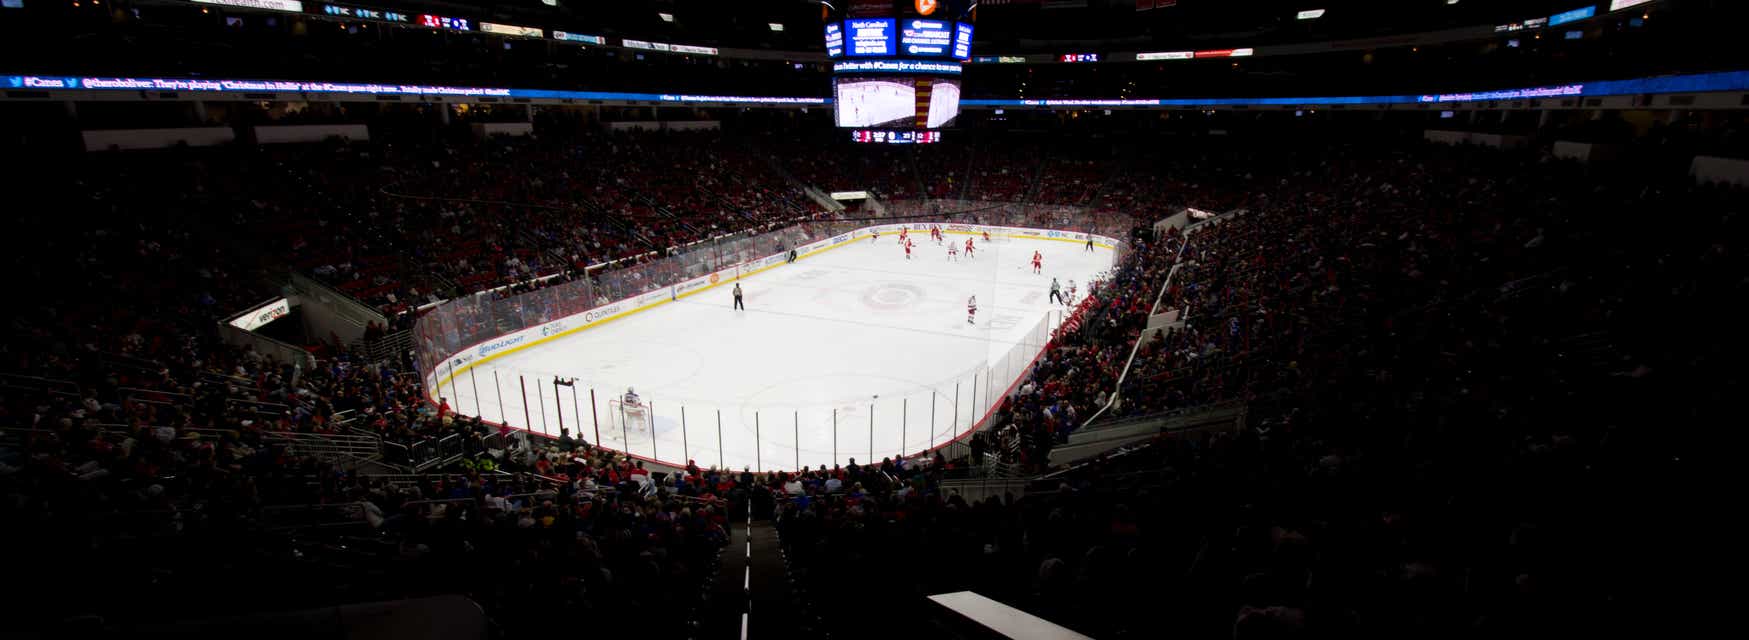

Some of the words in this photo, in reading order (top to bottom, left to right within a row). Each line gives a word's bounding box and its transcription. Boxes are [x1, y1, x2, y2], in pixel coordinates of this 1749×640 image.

[860, 62, 873, 70] with
[874, 61, 899, 70] #Canes
[899, 62, 909, 71] for
[915, 62, 936, 71] chance
[24, 76, 64, 88] #Canes
[153, 79, 188, 90] They're
[188, 80, 222, 91] playing
[265, 81, 276, 91] in
[301, 83, 310, 91] at
[310, 83, 322, 91] the
[323, 83, 348, 92] #Canes
[366, 85, 383, 93] right
[496, 335, 524, 351] LIGHT
